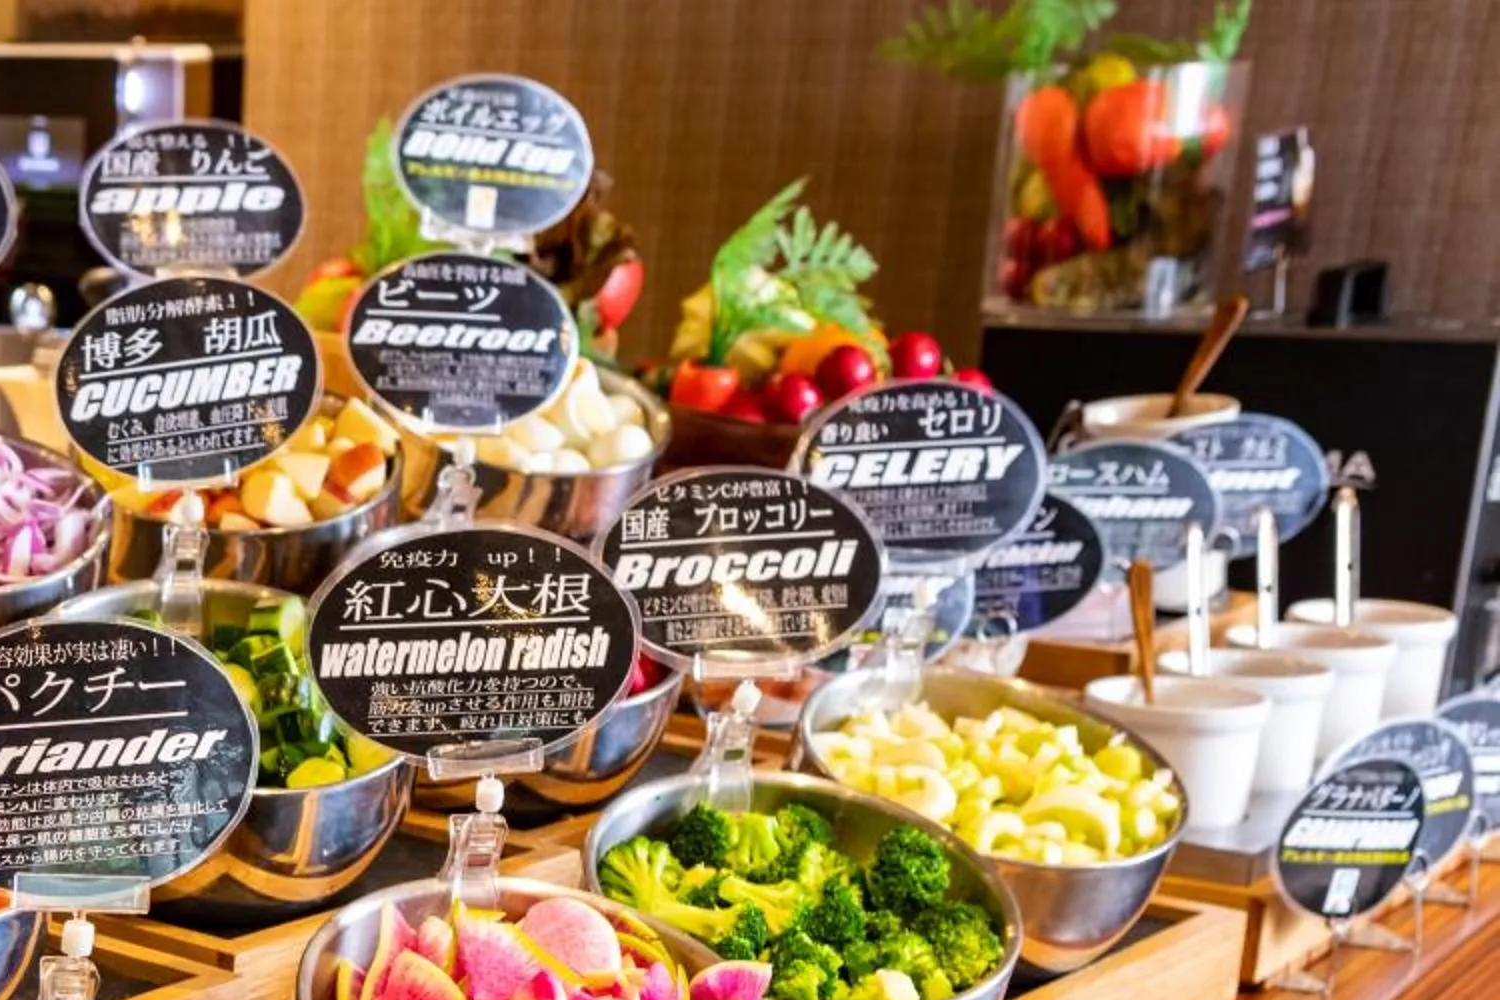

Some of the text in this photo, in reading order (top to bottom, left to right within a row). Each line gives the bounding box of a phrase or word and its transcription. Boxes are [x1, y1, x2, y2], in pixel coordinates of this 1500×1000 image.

[90, 182, 286, 215] apple
[378, 280, 501, 312] ビーツ
[82, 310, 282, 373] 博多 胡瓜
[352, 318, 557, 353] Beetroot
[70, 355, 302, 422] CUCUMBER
[918, 402, 1002, 438] セロリ
[809, 443, 1025, 490] CELERY
[621, 506, 670, 542] 国産
[694, 499, 833, 536] ブロッコリー
[380, 549, 458, 570] 免疫力
[613, 539, 859, 591] Broccoli
[342, 572, 592, 623] 紅心大根
[320, 631, 506, 678] watermelon
[508, 626, 611, 672] radish
